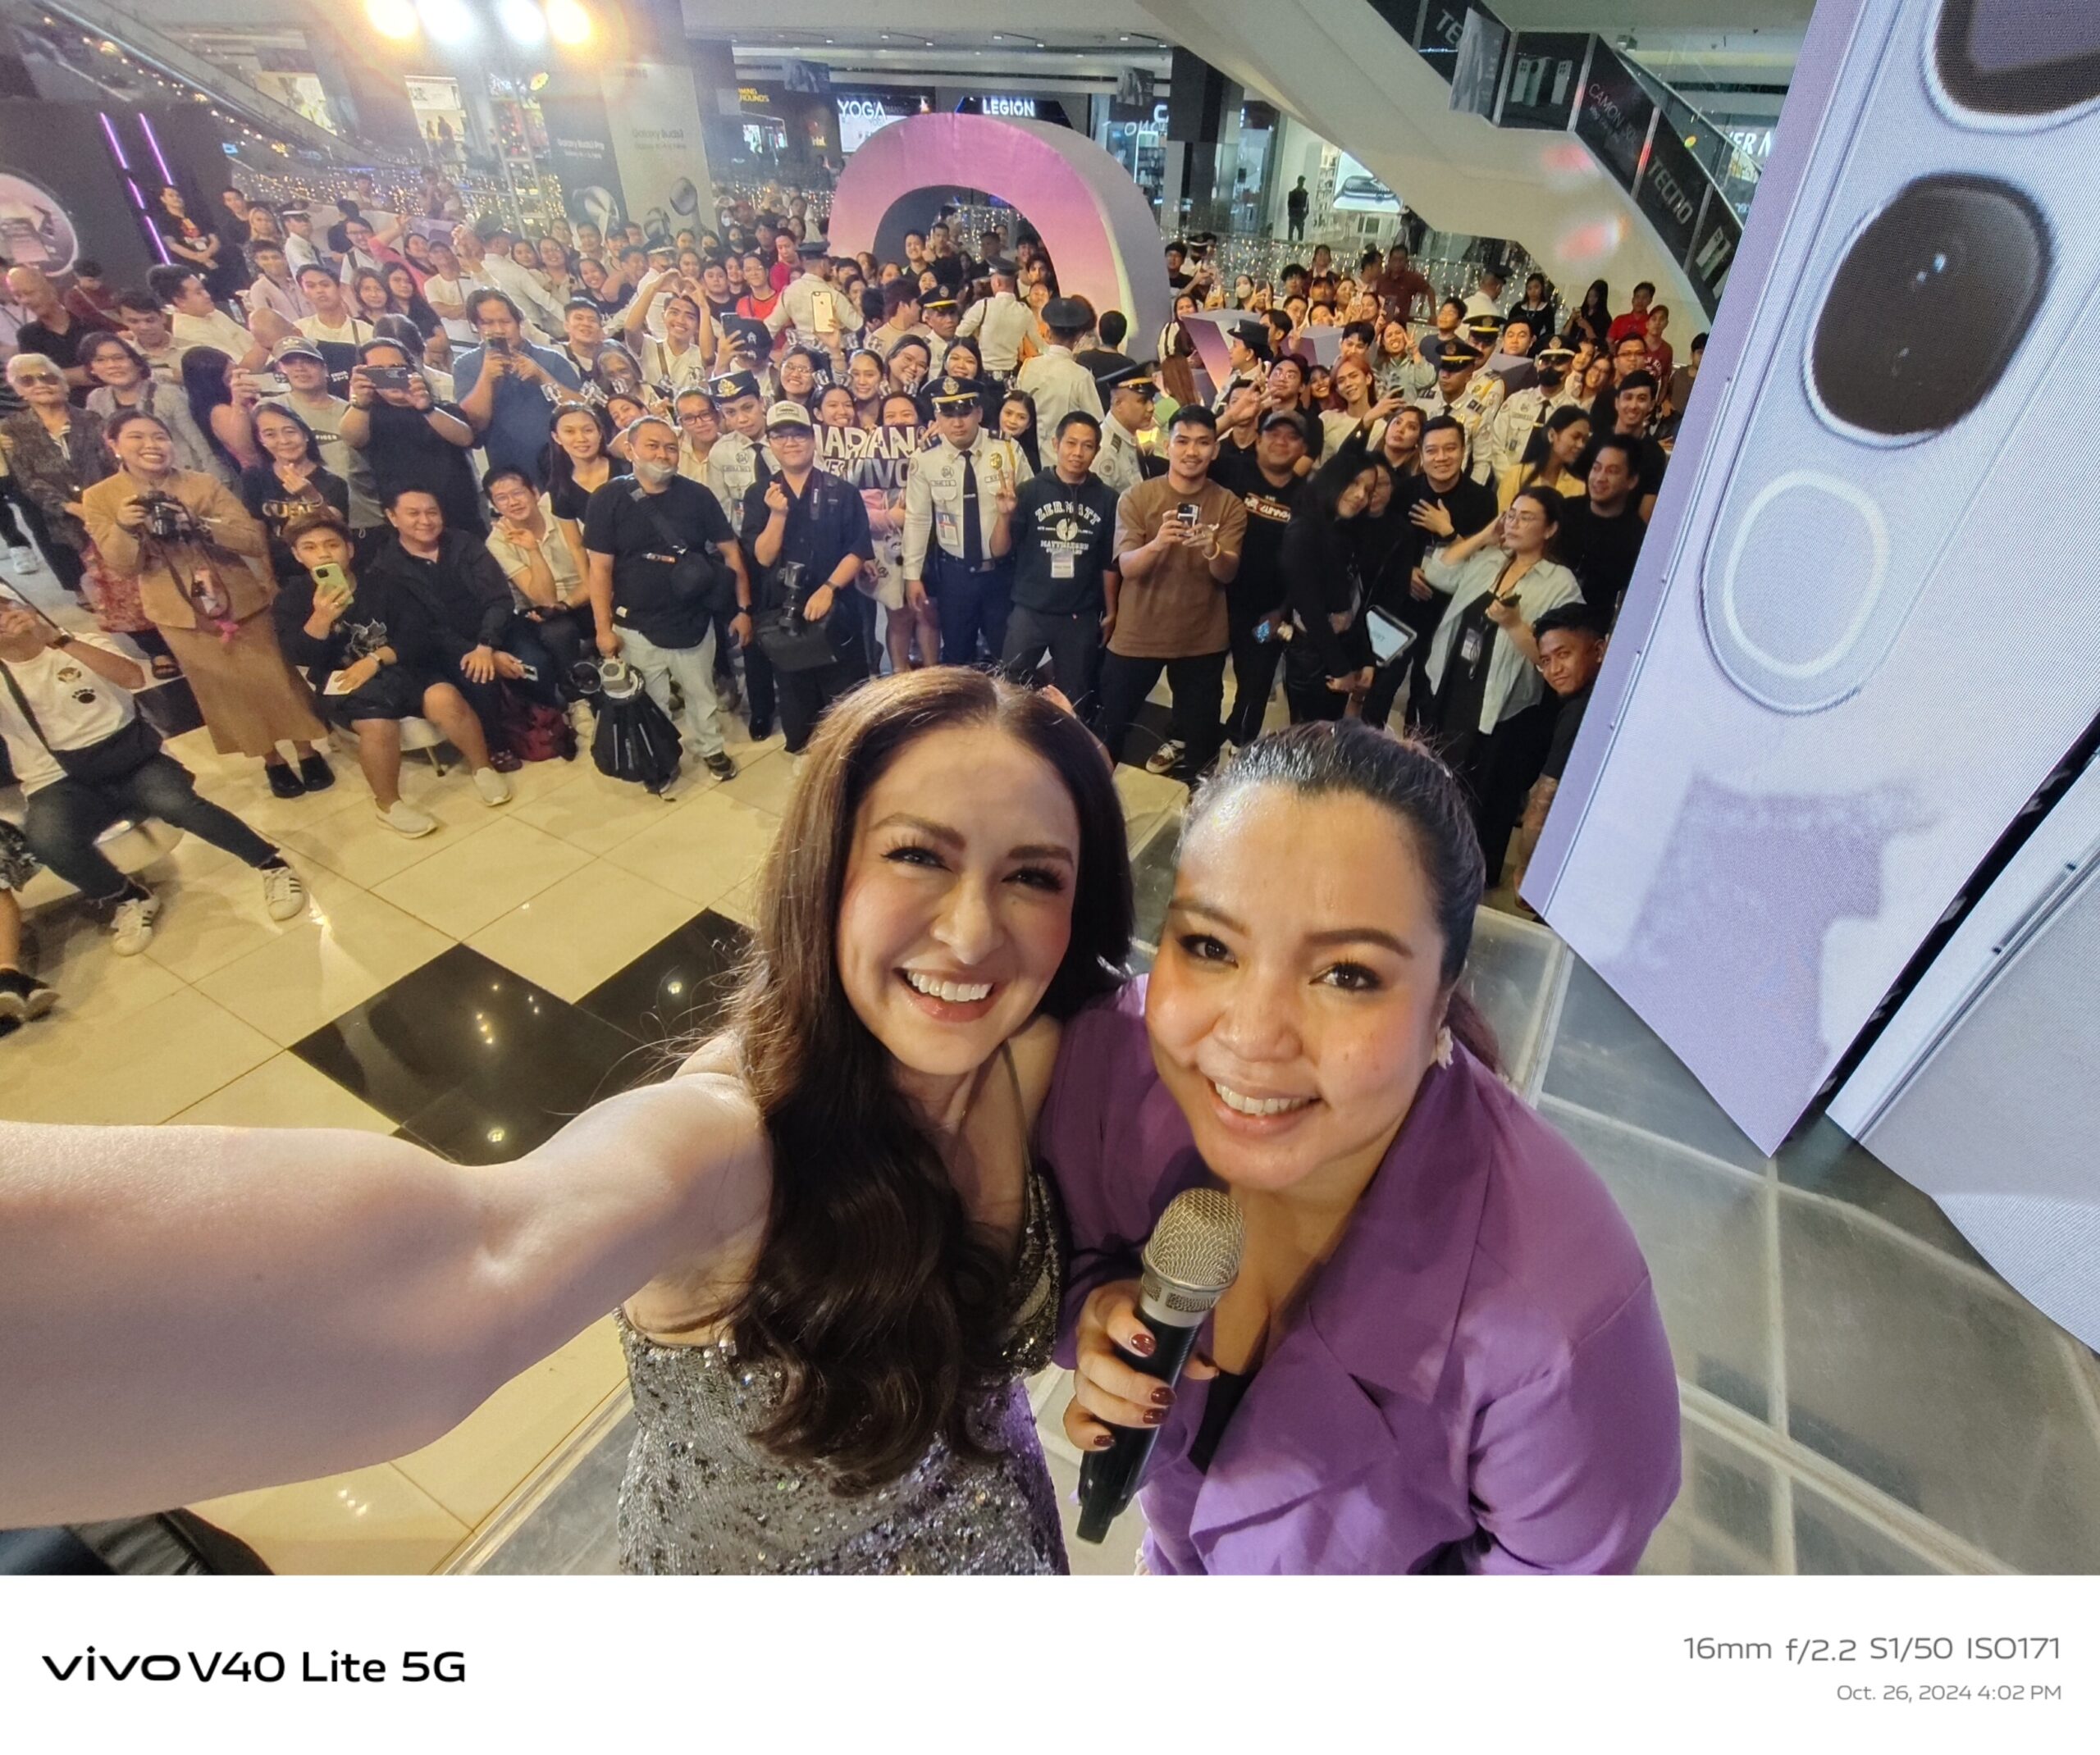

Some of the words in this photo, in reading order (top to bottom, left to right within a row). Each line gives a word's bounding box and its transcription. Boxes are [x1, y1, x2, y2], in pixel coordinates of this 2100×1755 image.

[1436, 8, 1463, 49] TE
[837, 98, 887, 122] YOGA
[982, 97, 1035, 117] LEGION
[1588, 84, 1625, 129] CAMON
[1648, 154, 1693, 225] TECNO
